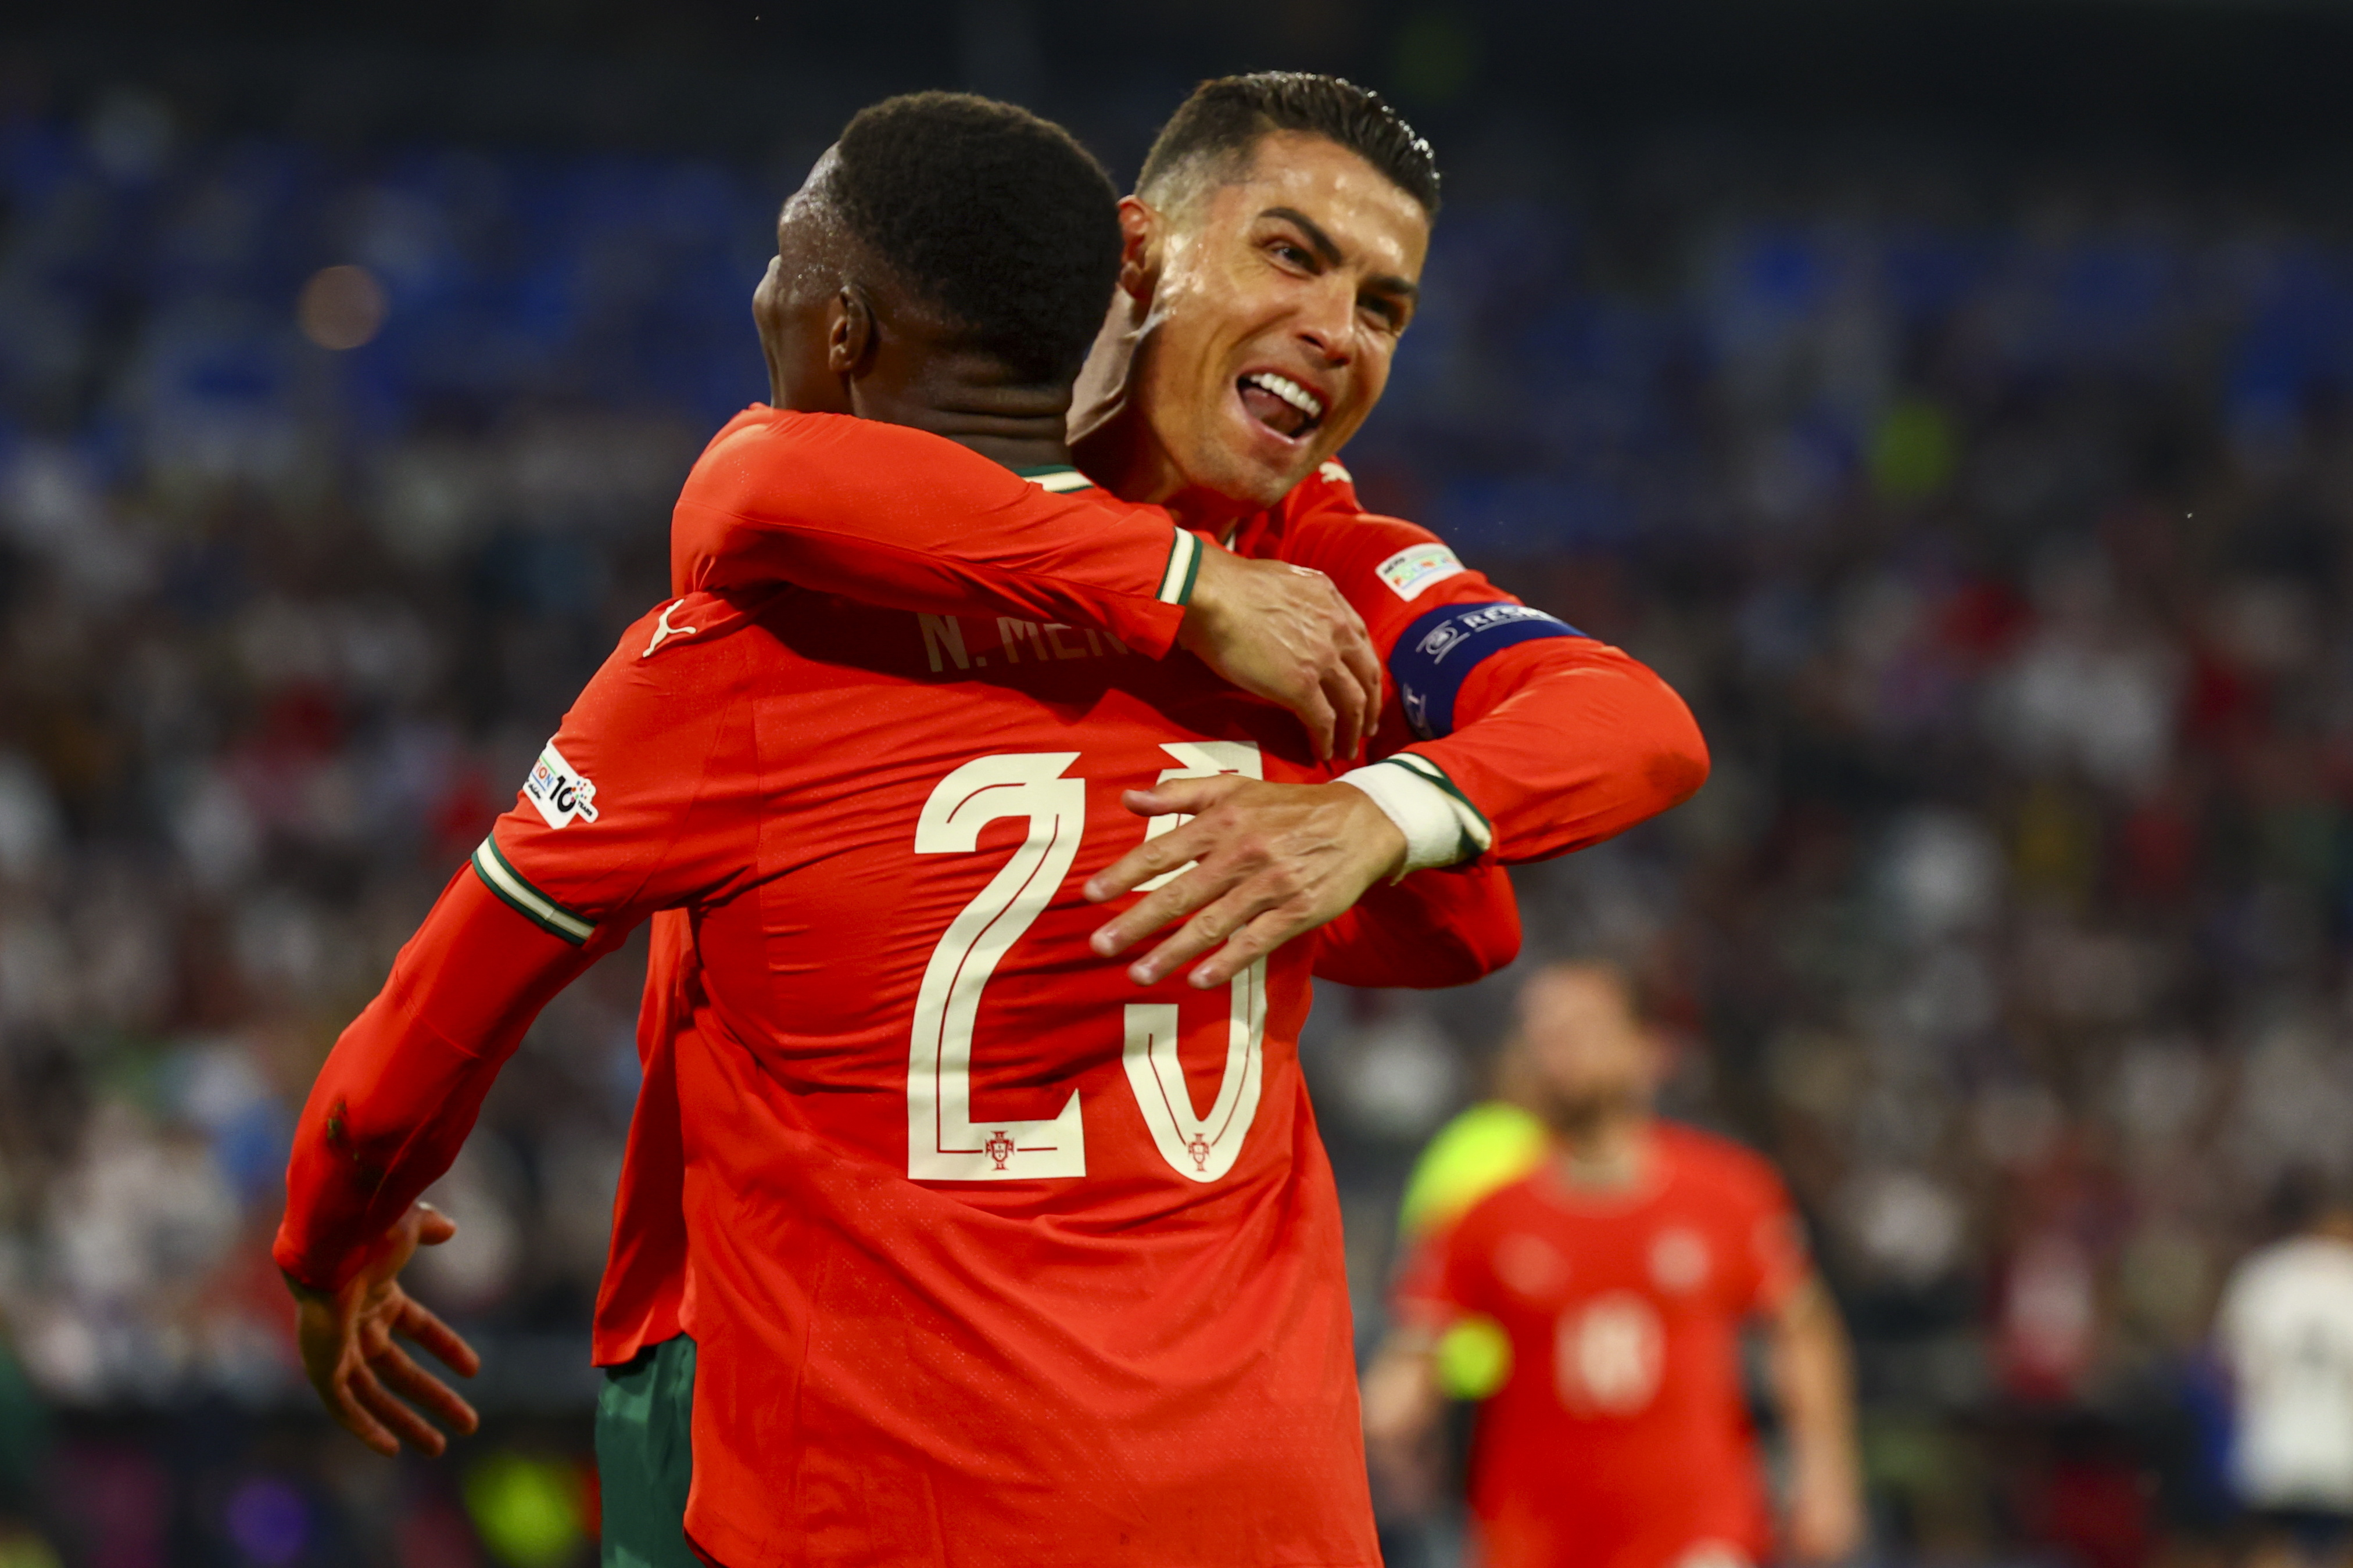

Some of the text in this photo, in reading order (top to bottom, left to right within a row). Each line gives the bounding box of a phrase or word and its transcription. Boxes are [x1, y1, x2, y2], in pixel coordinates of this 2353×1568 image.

[917, 613, 1129, 672] N. MEN
[550, 775, 576, 813] 10
